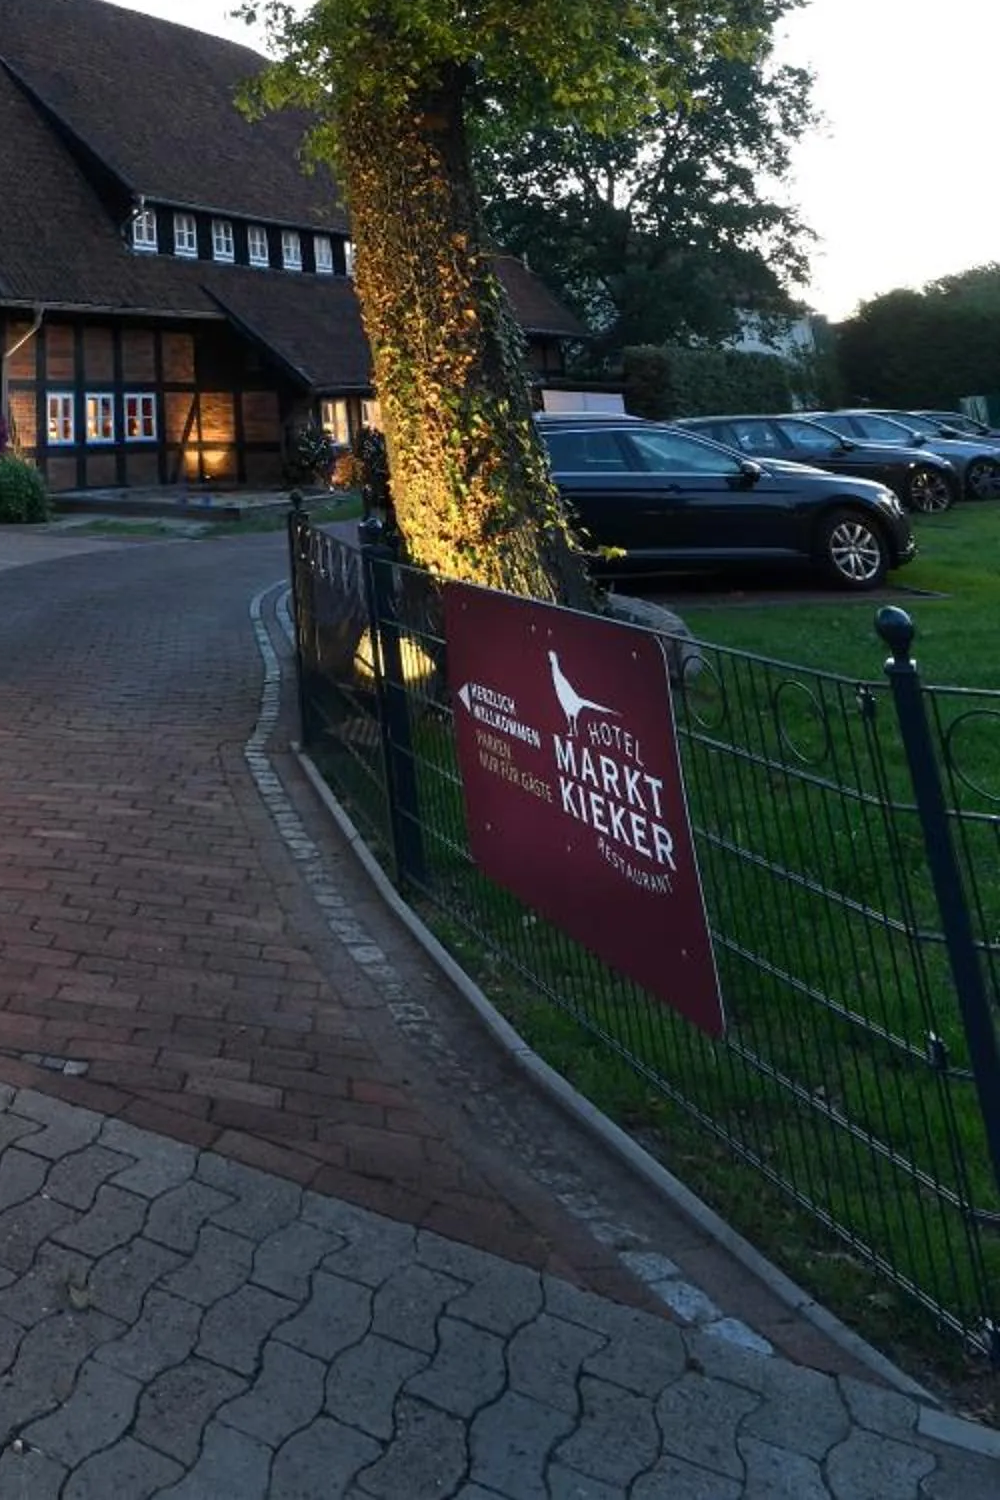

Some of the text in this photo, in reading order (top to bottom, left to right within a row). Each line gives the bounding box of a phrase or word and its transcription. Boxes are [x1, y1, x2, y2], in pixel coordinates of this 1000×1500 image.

[470, 683, 516, 714] HERZLICH
[472, 703, 541, 749] WILLKOMMEN
[475, 729, 512, 759] PARKEN
[588, 723, 645, 767] HOTEL
[554, 734, 663, 819] MARKT
[560, 776, 677, 871] KIEKER
[598, 836, 674, 893] RESTAURANT
